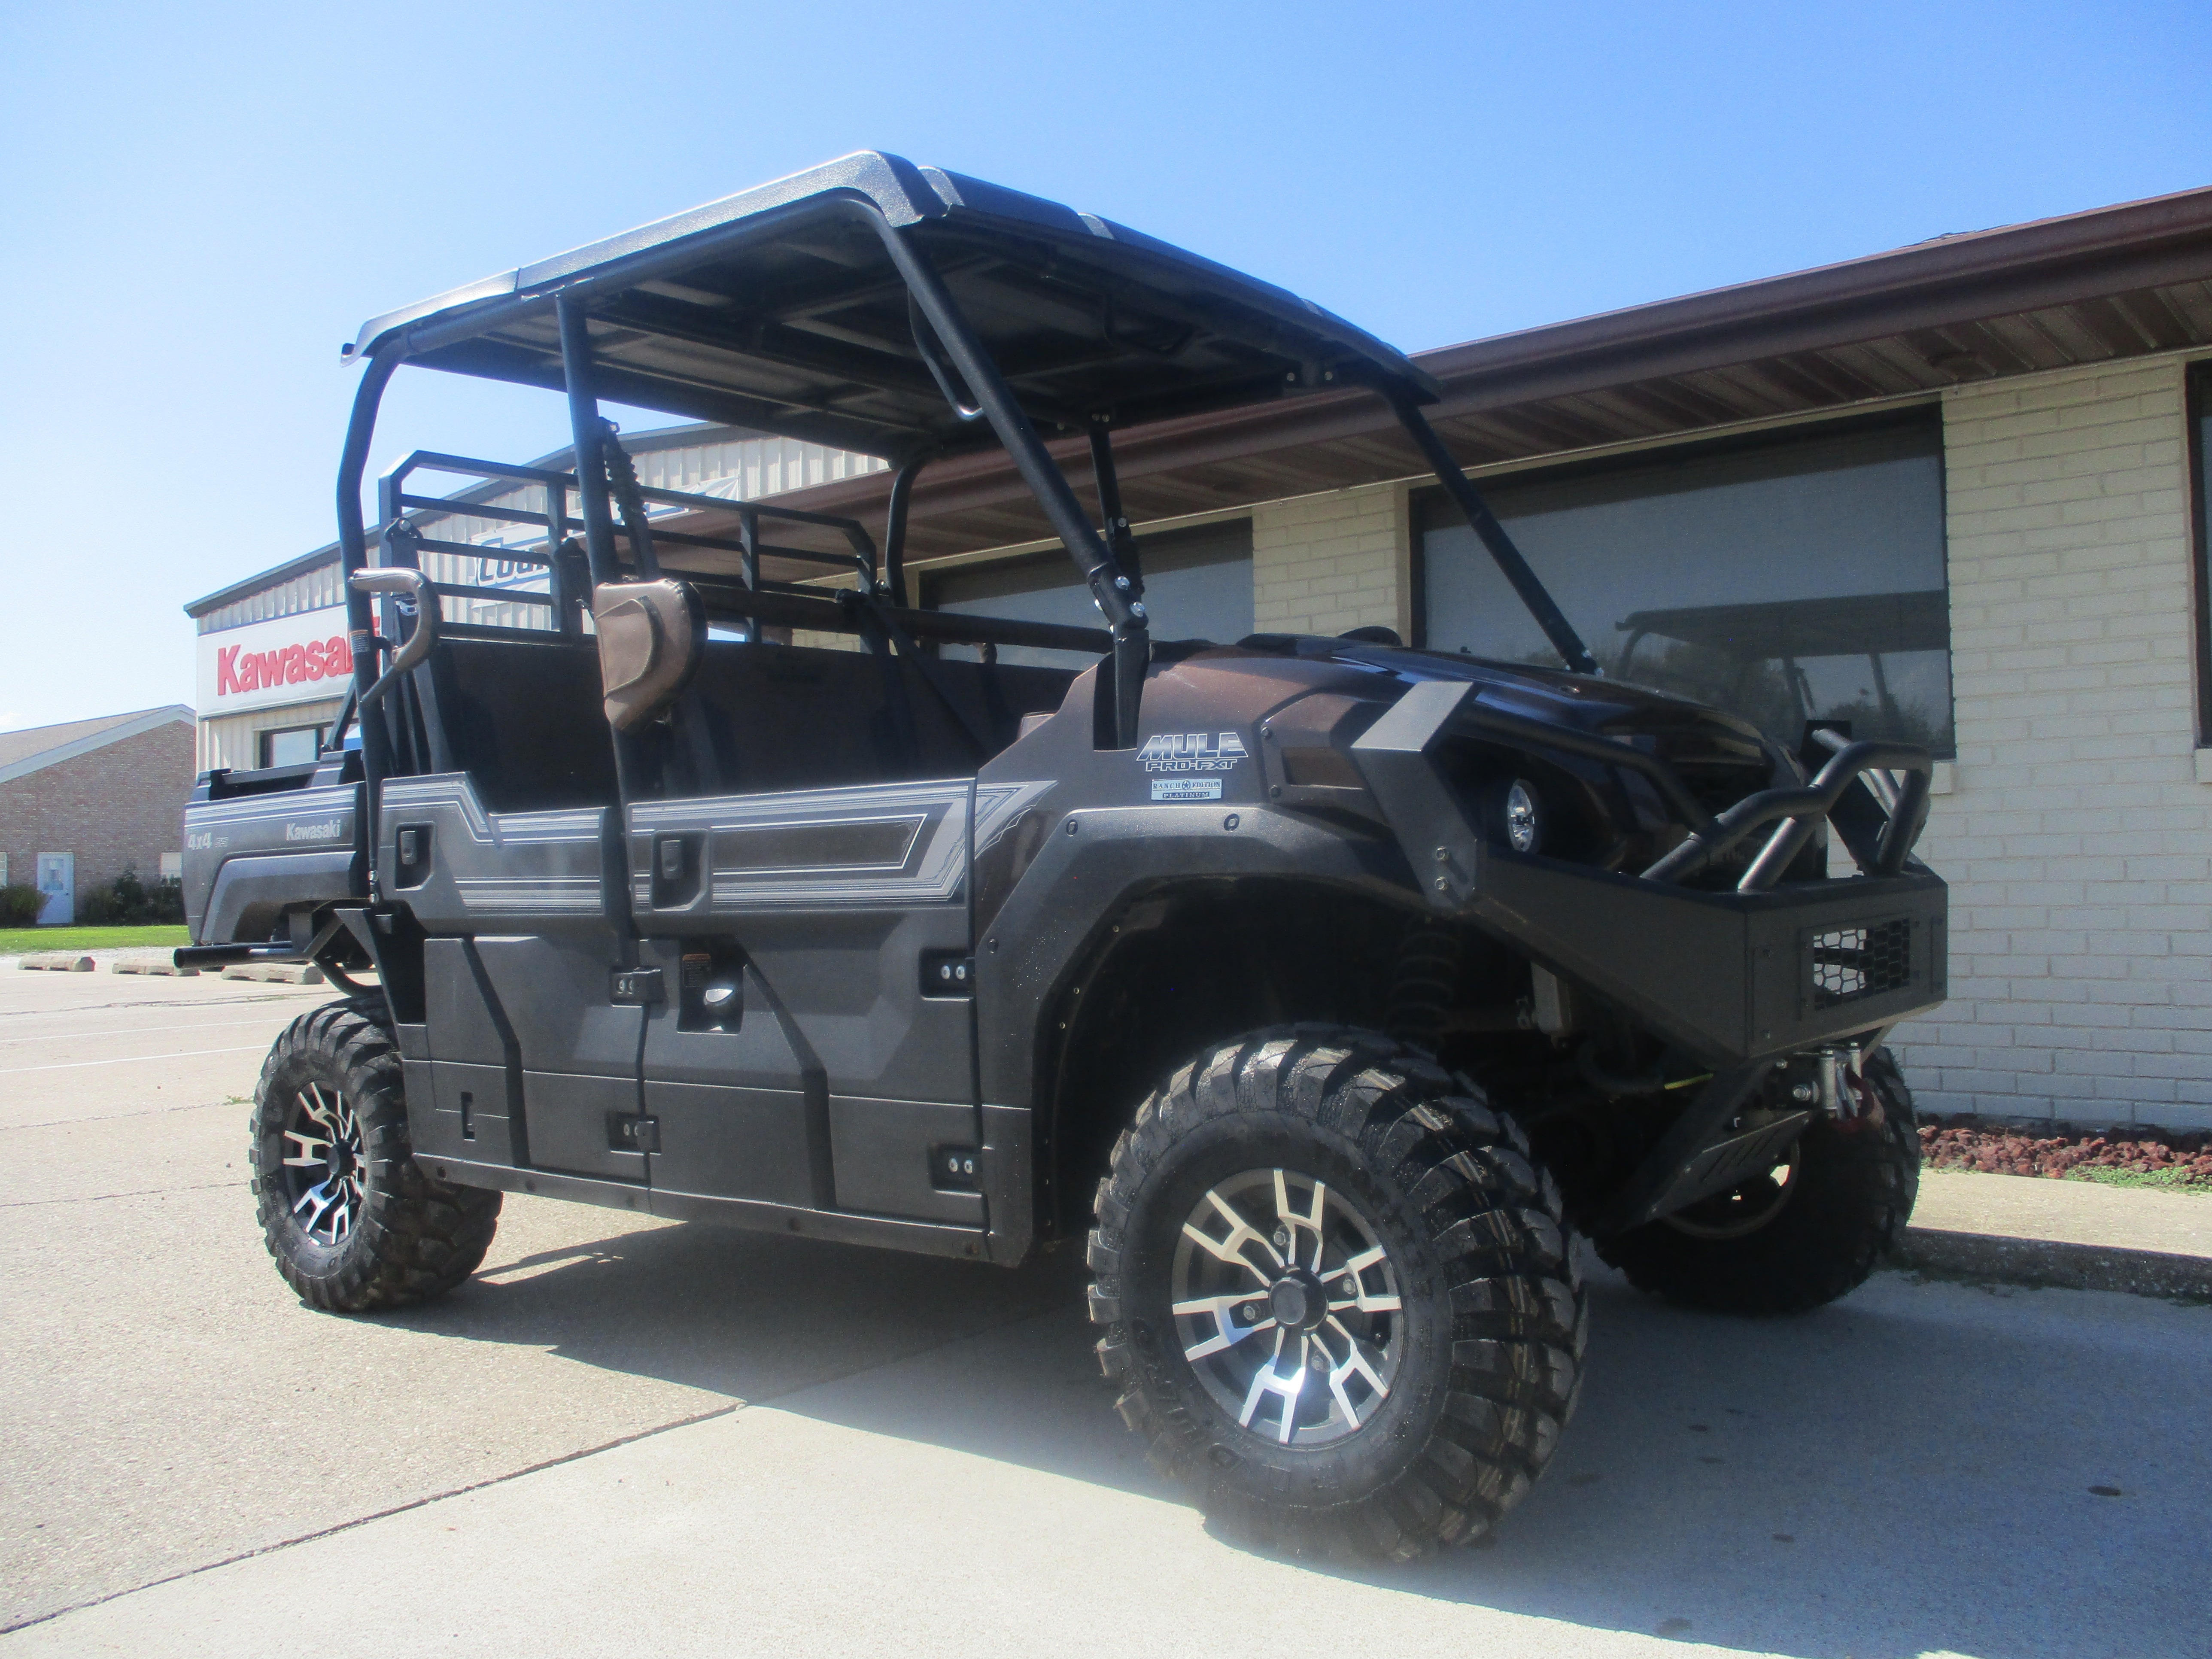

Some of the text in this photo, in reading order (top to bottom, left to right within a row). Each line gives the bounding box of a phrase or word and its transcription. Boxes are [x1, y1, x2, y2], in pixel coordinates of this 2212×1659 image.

[218, 616, 380, 696] Kawasa
[1136, 732, 1248, 761] MULE
[1146, 759, 1237, 772] PRO-FXT
[286, 819, 341, 841] Kawasaki
[188, 833, 212, 850] 4x4
